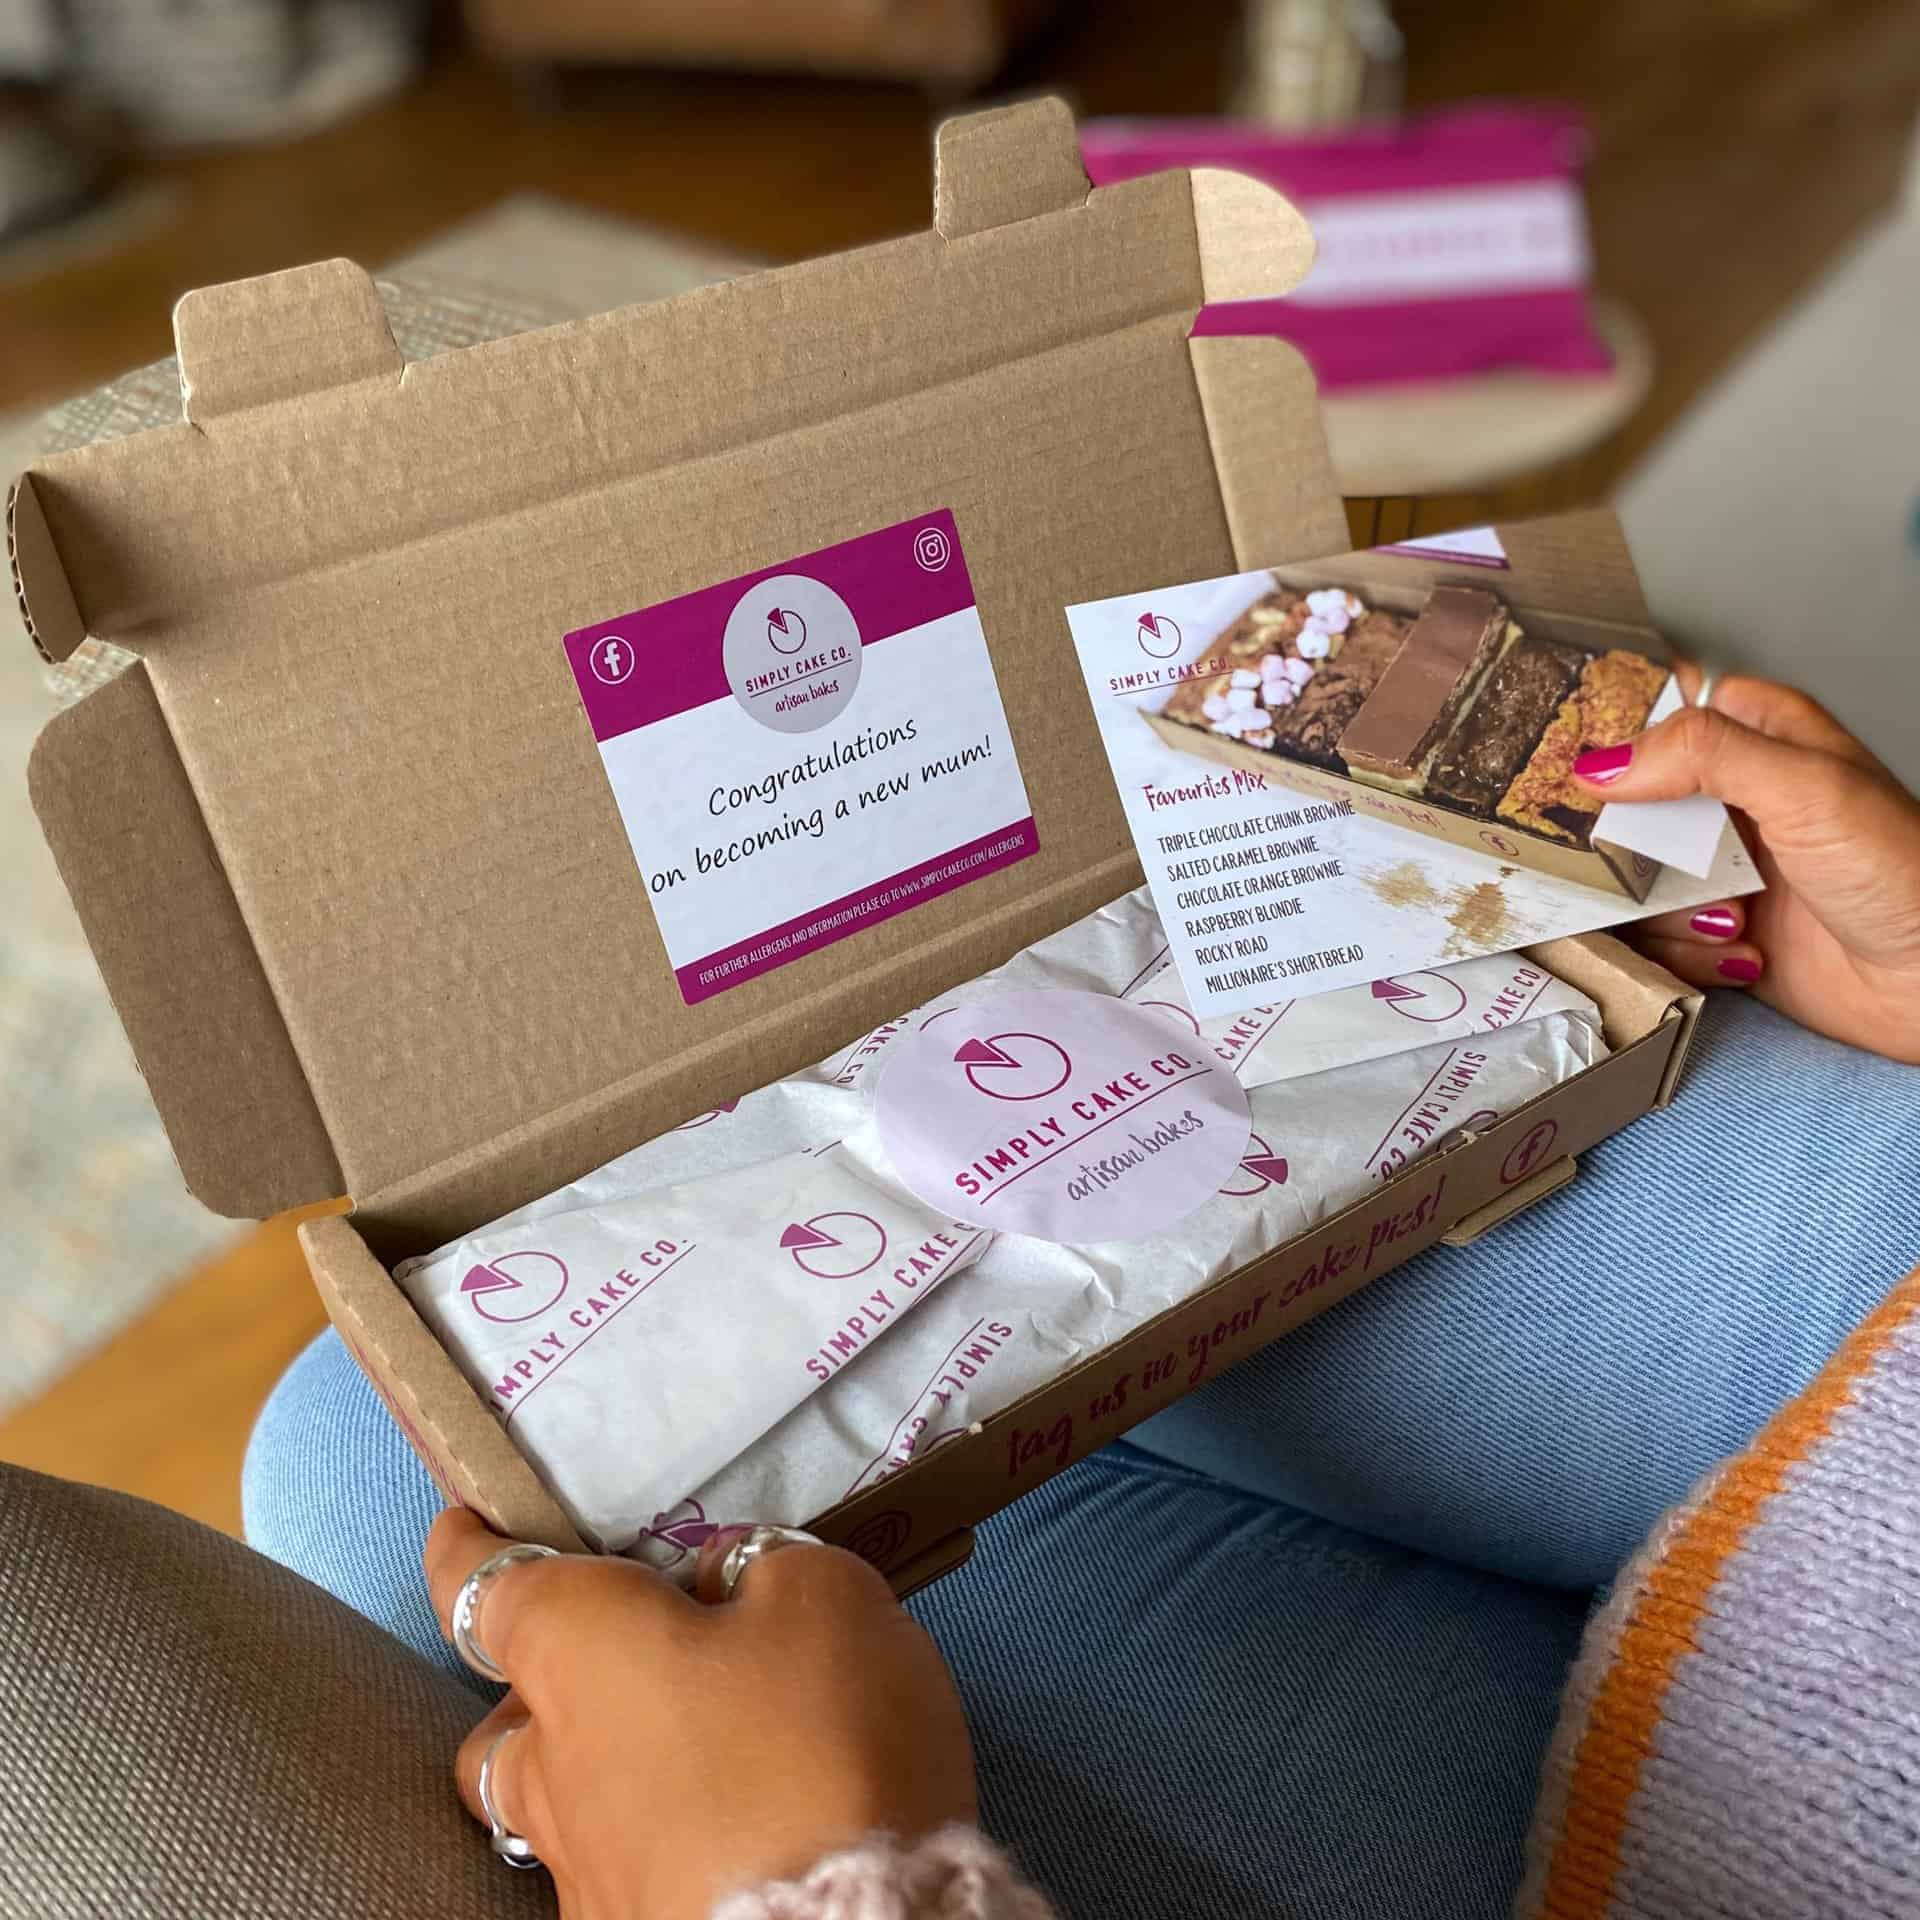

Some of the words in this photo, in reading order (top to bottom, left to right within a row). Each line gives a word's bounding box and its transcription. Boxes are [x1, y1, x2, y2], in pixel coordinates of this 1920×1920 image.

[745, 666, 790, 692] SIMPLY
[796, 653, 827, 674] CAKE
[831, 646, 851, 661] CO.
[809, 680, 839, 699] bakes
[1110, 670, 1160, 690] SIMPLY
[1168, 662, 1203, 680] CAKE
[709, 719, 918, 816] Congratulations
[1142, 774, 1231, 812] Favourites
[1231, 769, 1268, 796] Mix
[651, 868, 687, 893] on
[695, 807, 824, 874] becoming
[835, 799, 849, 819] a
[859, 772, 910, 809] new
[921, 734, 992, 783] mum!
[1157, 831, 1199, 854] TRIPLE
[1199, 817, 1270, 846] CHOCOLATE
[1264, 812, 1304, 832] CHUNK
[1303, 799, 1356, 824] BROWNIE
[1167, 859, 1211, 882] SALTED
[1212, 844, 1269, 873] CARAMEL
[1268, 835, 1320, 861] BROWNIE
[1176, 881, 1244, 910] CHOCOLATE
[1243, 870, 1292, 895] ORANGE
[1291, 859, 1345, 885] BROWNIE
[699, 970, 716, 985] FOR
[714, 954, 750, 979] FURTHER
[749, 937, 793, 964] ALLERGENS
[791, 928, 808, 944] AND
[807, 909, 853, 938] INFORMATION
[852, 896, 880, 918] PLEASE
[880, 893, 890, 906] GO
[891, 890, 900, 900] TO
[1185, 910, 1255, 938] RASPBERRY
[1254, 897, 1305, 922] BLONDIE
[1194, 943, 1236, 966] ROCKY
[1235, 935, 1269, 956] ROAD
[1205, 962, 1288, 994] MILLIONAIRE'S
[1286, 944, 1365, 976] SHORTBREAD
[1214, 1016, 1262, 1060] CAKE
[1434, 1052, 1487, 1100] SIMPLY
[954, 1117, 1067, 1195] SIMPLY
[1071, 1072, 1151, 1121] CAKE
[1150, 1053, 1203, 1077] CO.
[1403, 1102, 1448, 1148] CAKE
[1067, 1148, 1144, 1200] artisan
[1128, 1110, 1204, 1154] bakes
[569, 1269, 640, 1328] CAKE
[640, 1239, 688, 1266] CO.
[805, 1289, 895, 1381] SIMPLY
[893, 1232, 958, 1288] CAKE
[1089, 1373, 1133, 1421] us
[1142, 1351, 1178, 1390] in
[1188, 1291, 1271, 1385] your
[1279, 1244, 1360, 1308] cake
[1364, 1174, 1447, 1272] pics!
[931, 1322, 1013, 1408] SIMPLY
